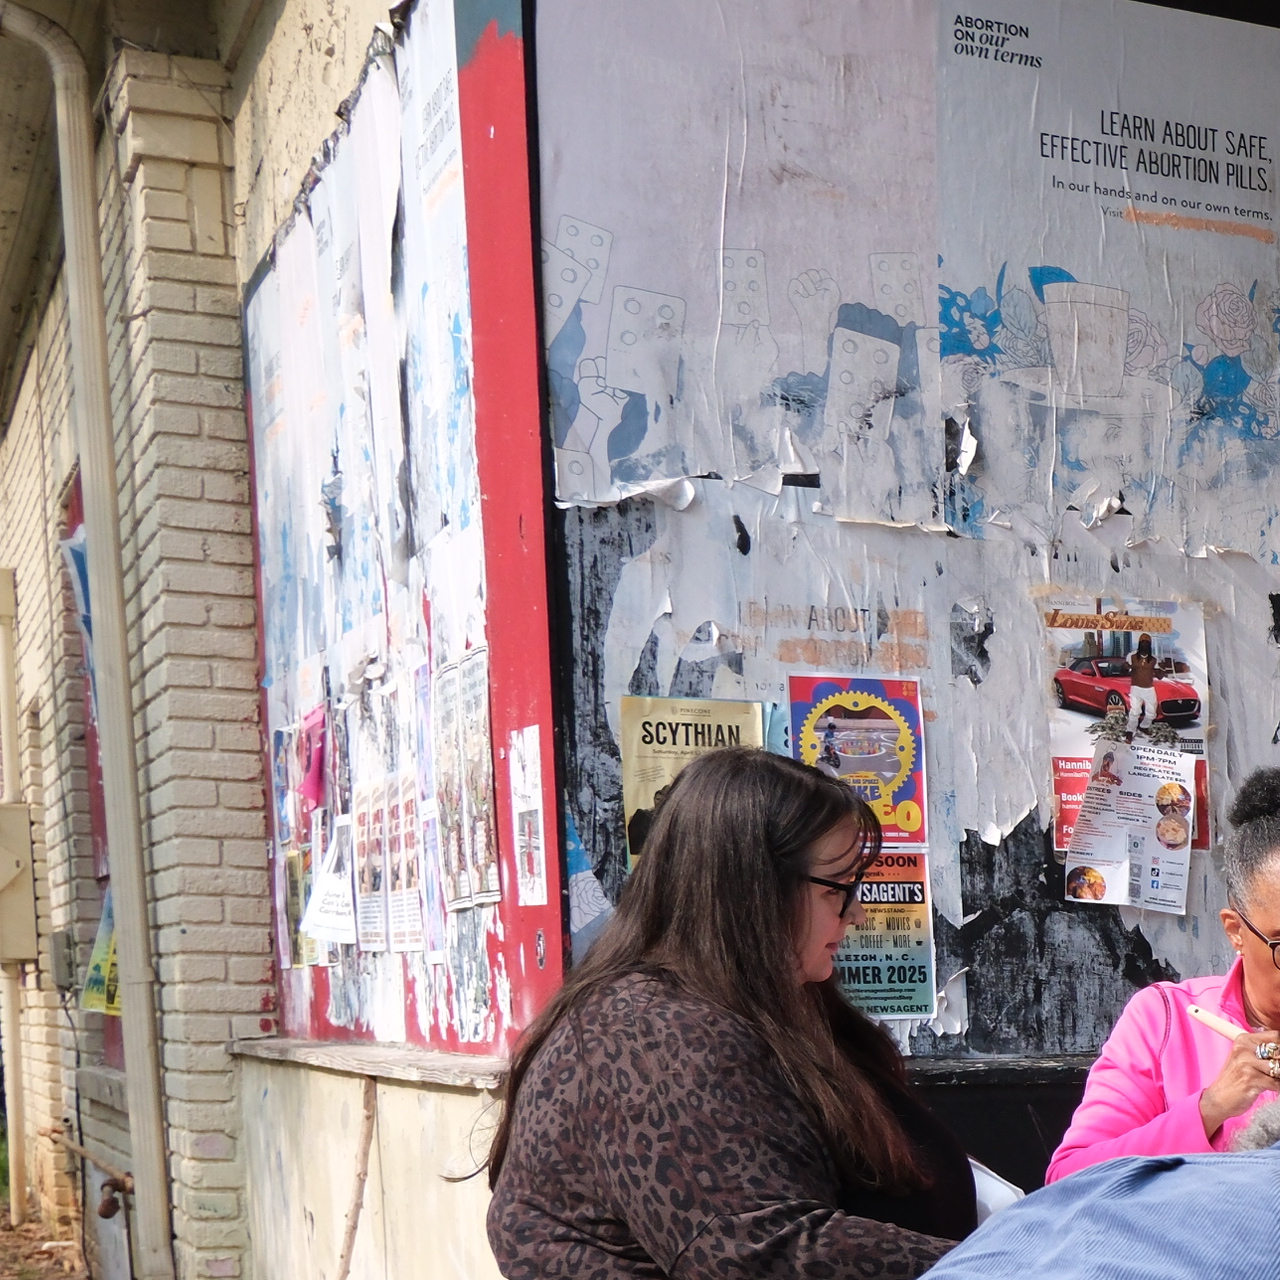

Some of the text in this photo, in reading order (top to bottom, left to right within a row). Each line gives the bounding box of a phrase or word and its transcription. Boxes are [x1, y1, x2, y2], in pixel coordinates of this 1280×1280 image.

[954, 14, 1030, 39] ABORTION
[954, 29, 1010, 48] ON our
[954, 43, 1043, 69] own terms
[1100, 110, 1273, 165] LEARN ABOUT SAFE,
[1040, 132, 1273, 194] EFFECTIVE ABORTION PILLS.
[1052, 175, 1273, 222] In our hands and on our own terms.
[1101, 205, 1124, 219] Visit
[641, 721, 740, 747] SCYTHIAN
[1130, 745, 1184, 758] OPEN DAILY
[875, 856, 917, 867] SOON
[886, 917, 911, 931] MOVIES
[860, 935, 911, 949] COFFEE MORE
[887, 965, 927, 984] 2025
[866, 1004, 929, 1013] NEWSAGENT
